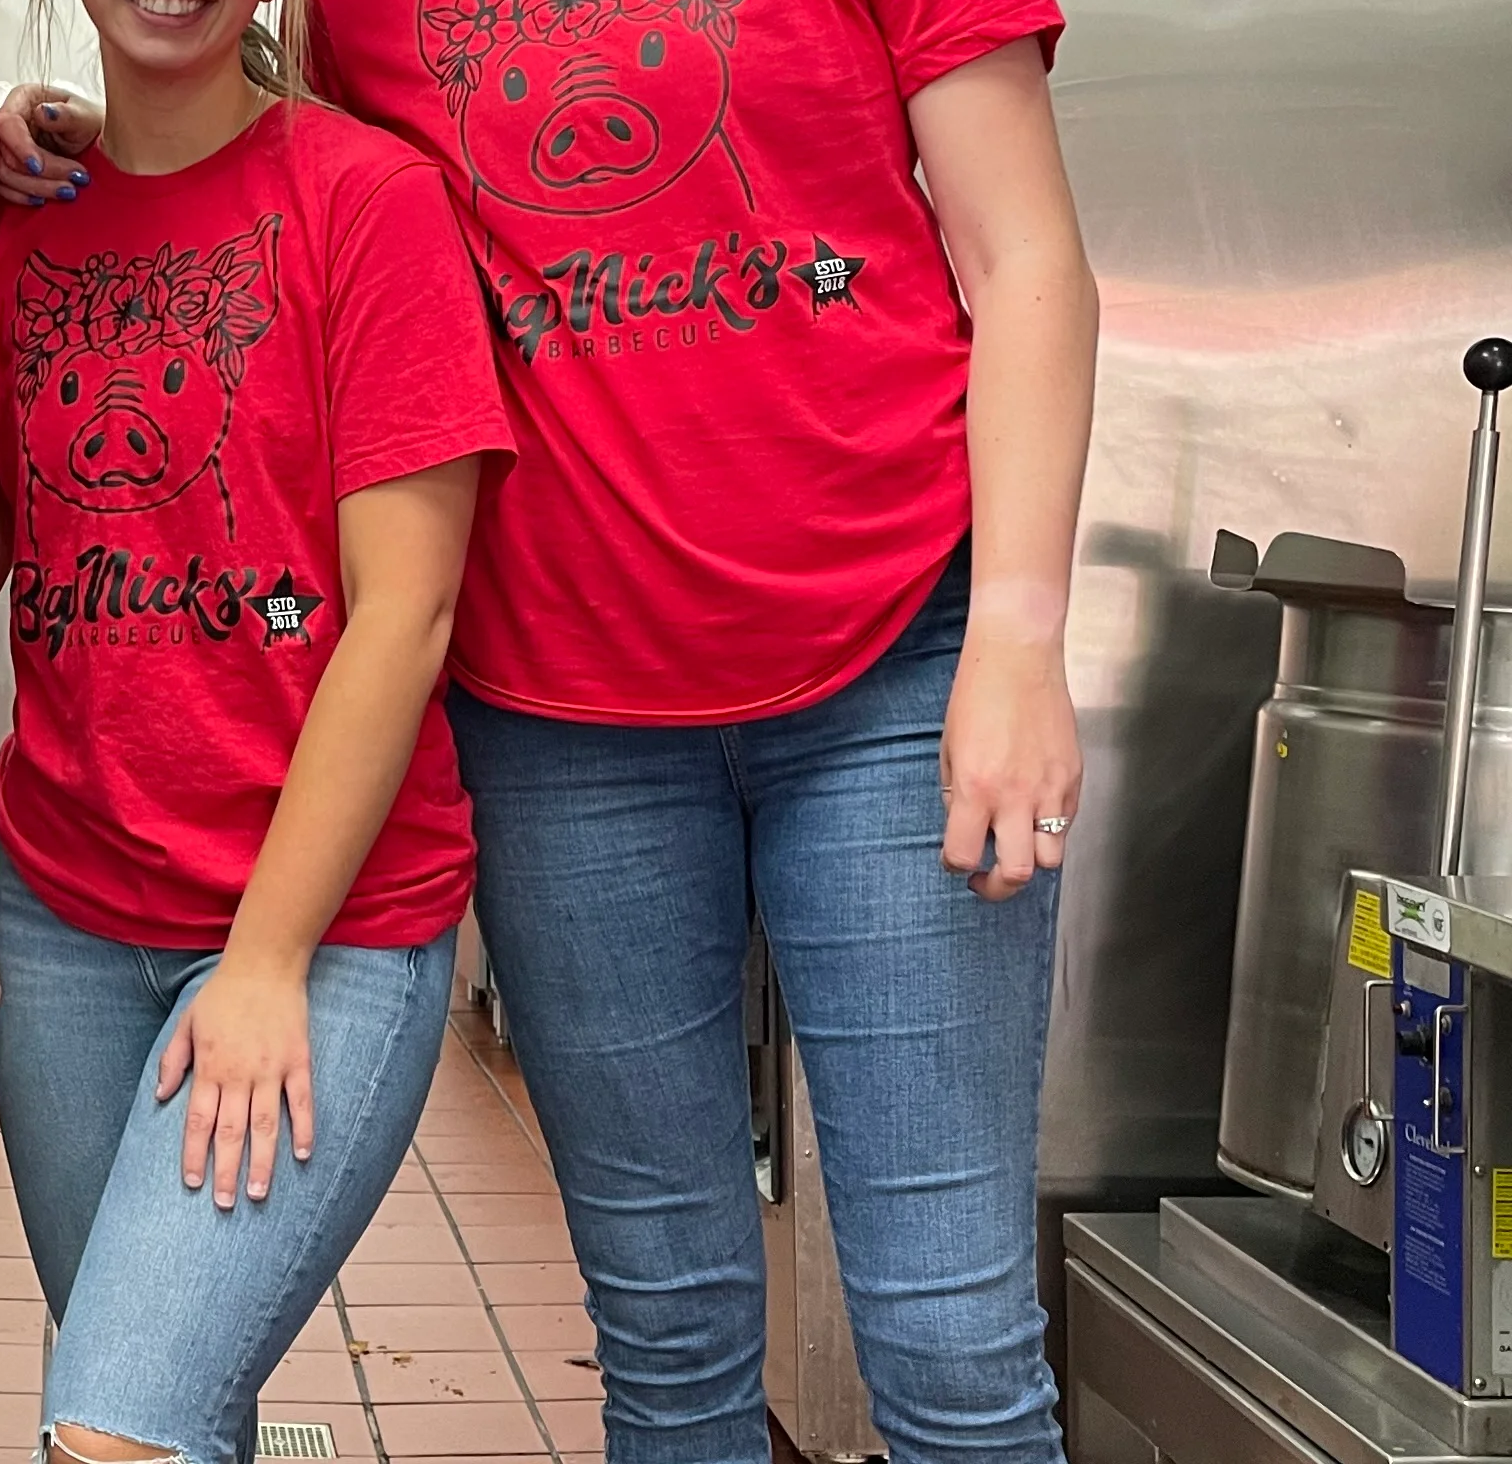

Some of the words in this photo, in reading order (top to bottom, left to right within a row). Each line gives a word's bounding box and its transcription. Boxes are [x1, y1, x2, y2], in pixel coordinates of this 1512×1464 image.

[814, 258, 846, 276] ESTD
[817, 276, 846, 294] 2018
[496, 273, 563, 369] ig
[543, 232, 788, 332] Nick's
[548, 320, 721, 359] BARBECUE
[267, 597, 296, 612] ESTD
[270, 614, 299, 630] 2018
